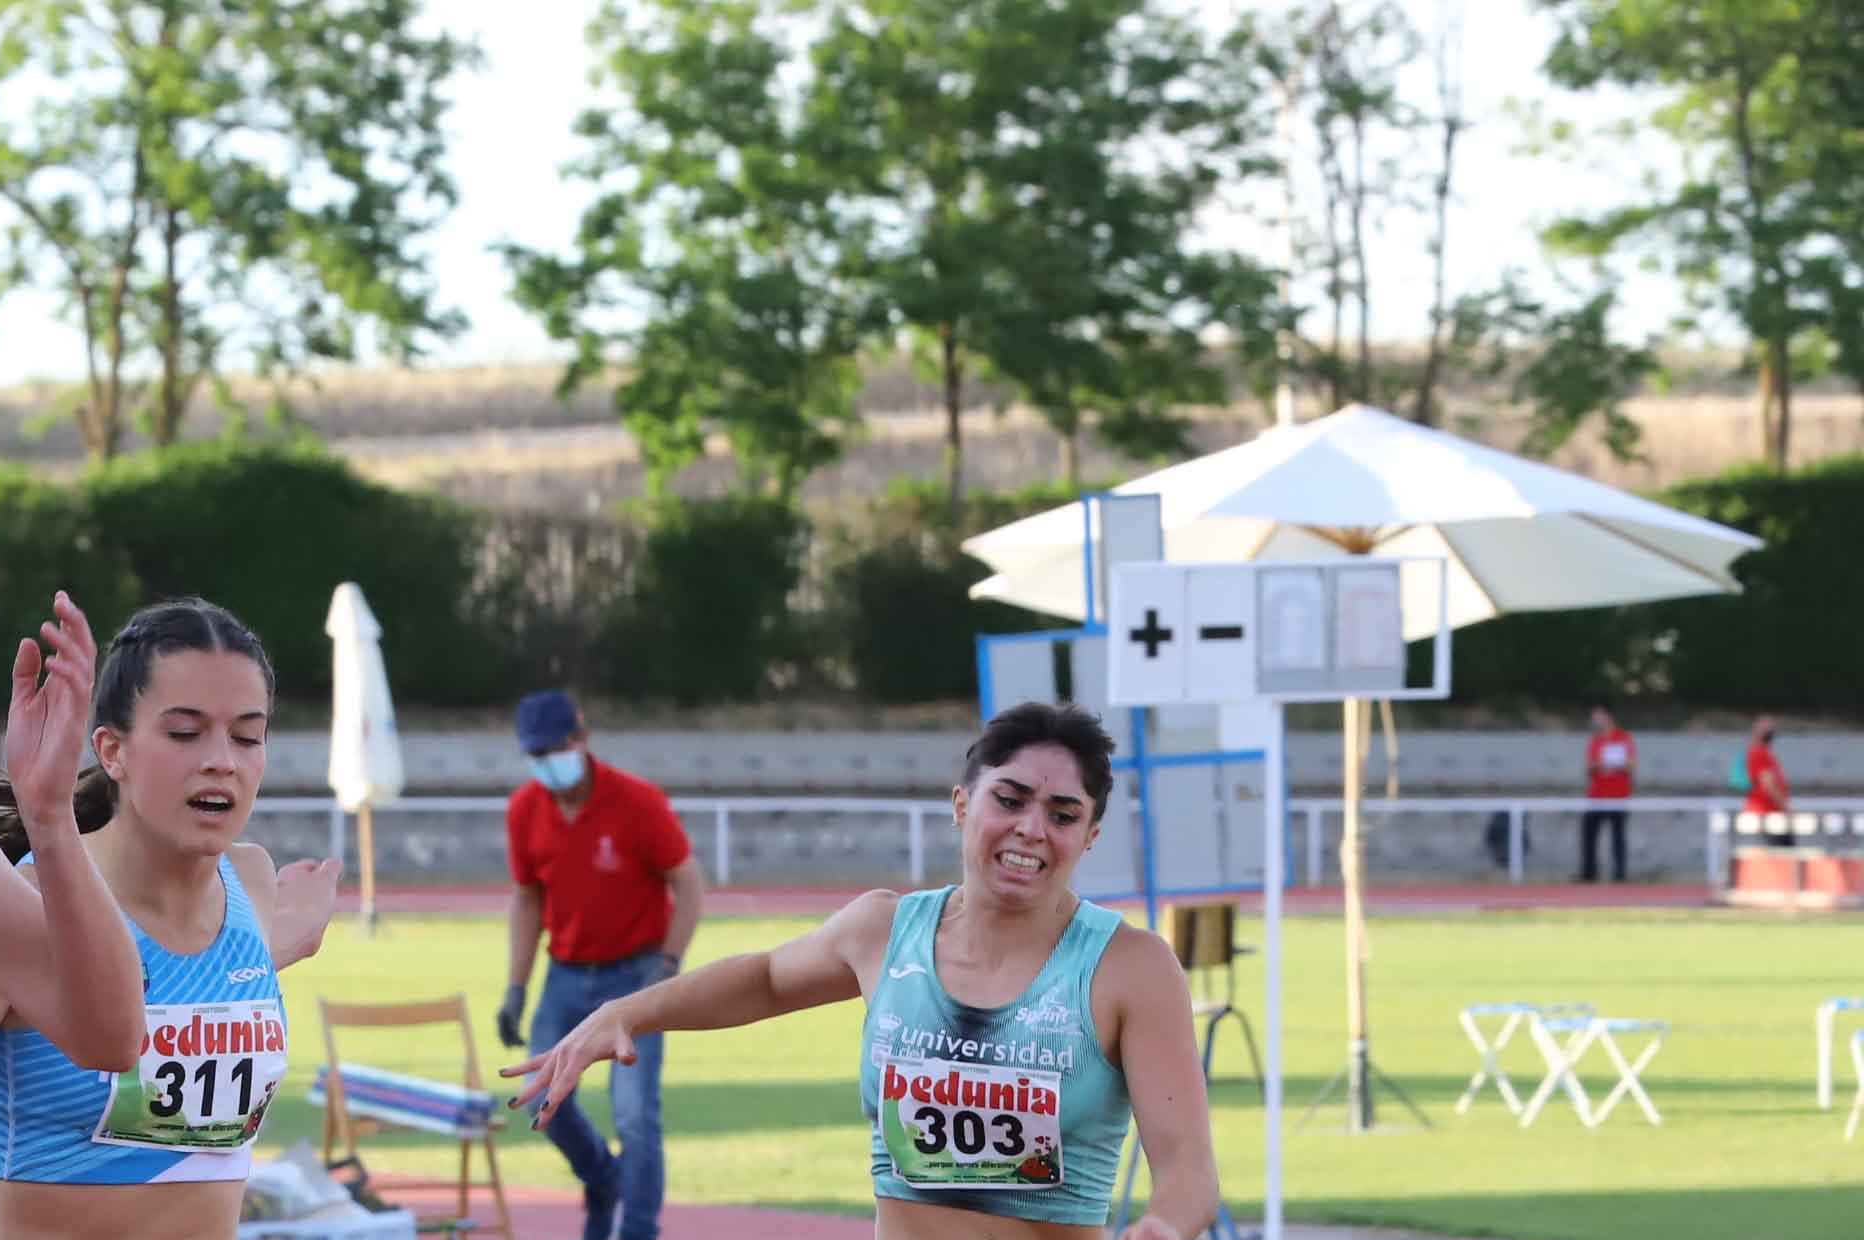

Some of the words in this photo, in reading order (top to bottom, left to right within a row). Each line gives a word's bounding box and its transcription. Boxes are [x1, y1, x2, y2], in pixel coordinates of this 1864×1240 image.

[901, 1026, 1074, 1069] universidad
[148, 1057, 254, 1118] 311
[883, 1064, 1056, 1116] bedunia
[912, 1106, 1026, 1157] 303
